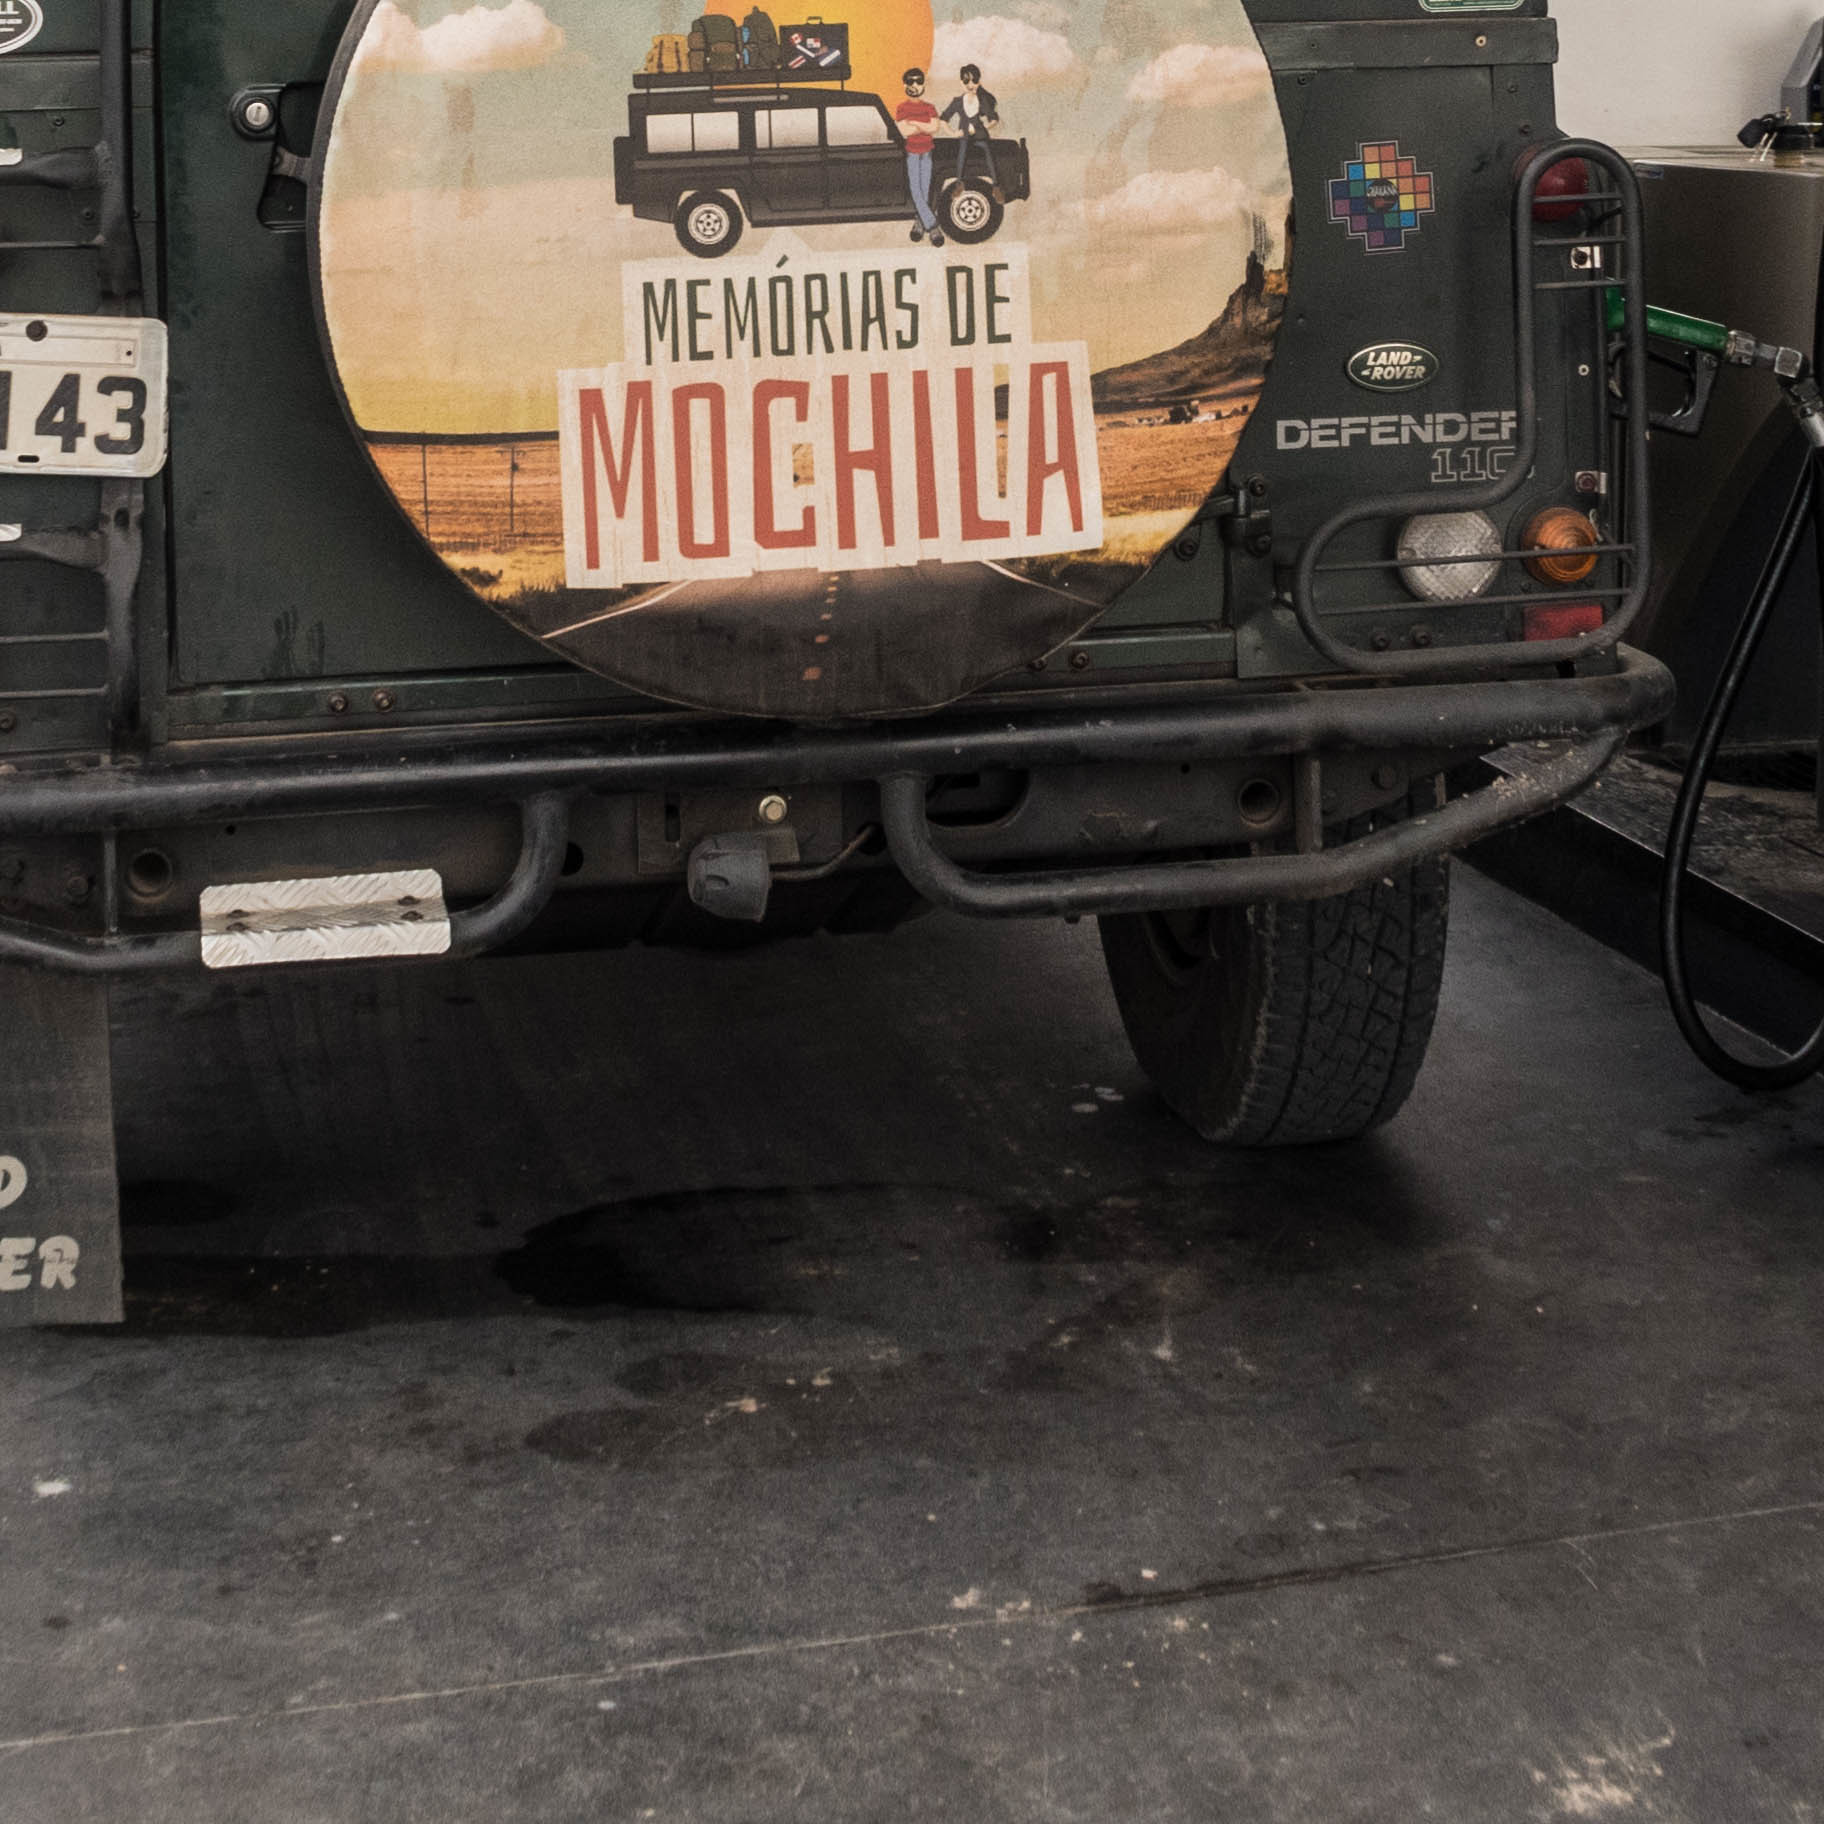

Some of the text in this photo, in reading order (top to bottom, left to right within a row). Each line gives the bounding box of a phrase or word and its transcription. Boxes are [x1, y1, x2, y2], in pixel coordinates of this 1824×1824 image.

[642, 255, 1013, 366] MEMÓRIAS DE
[1366, 351, 1413, 366] LAND
[1371, 365, 1426, 381] ROVER
[579, 361, 1084, 570] MOCHILA
